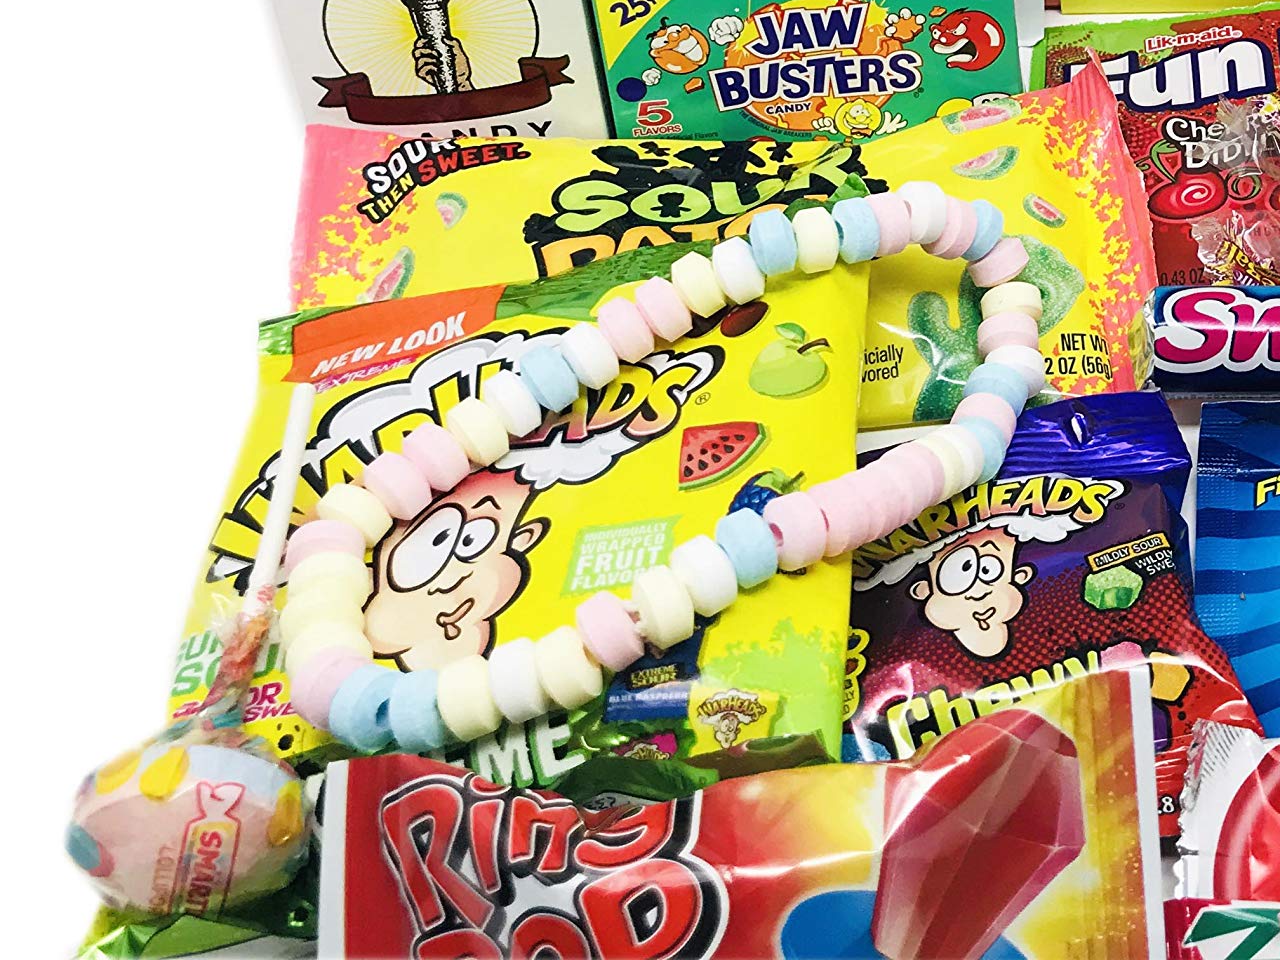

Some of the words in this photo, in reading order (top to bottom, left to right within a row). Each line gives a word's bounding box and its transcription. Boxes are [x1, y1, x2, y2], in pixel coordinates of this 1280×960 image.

[749, 2, 869, 59] JAW
[708, 51, 924, 113] BUSTERS
[1065, 37, 1276, 112] Fun
[637, 99, 673, 128] 5
[765, 101, 812, 116] CANDY
[632, 124, 682, 138] FLAVORS
[1165, 116, 1227, 142] Che
[366, 138, 456, 195] SOUR
[361, 171, 416, 221] THEN
[555, 146, 856, 233] SOUR
[313, 340, 375, 377] NEW
[389, 311, 467, 353] LOOK
[861, 344, 905, 367] icially
[1060, 332, 1087, 352] NET
[312, 355, 416, 394] EXTREME
[860, 362, 900, 383] vored
[1044, 356, 1054, 375] 2
[1058, 356, 1077, 374] OZ
[579, 532, 667, 555] WRAPPED
[581, 521, 668, 542] INDIVIDUALLY
[574, 544, 665, 576] FRUIT
[1094, 544, 1129, 567] MILDLY
[1131, 536, 1163, 553] SOUR
[1134, 548, 1175, 571] WILDLY
[570, 566, 642, 591] FLAVO
[1146, 560, 1177, 577] SWE
[697, 694, 768, 722] WARHEADS
